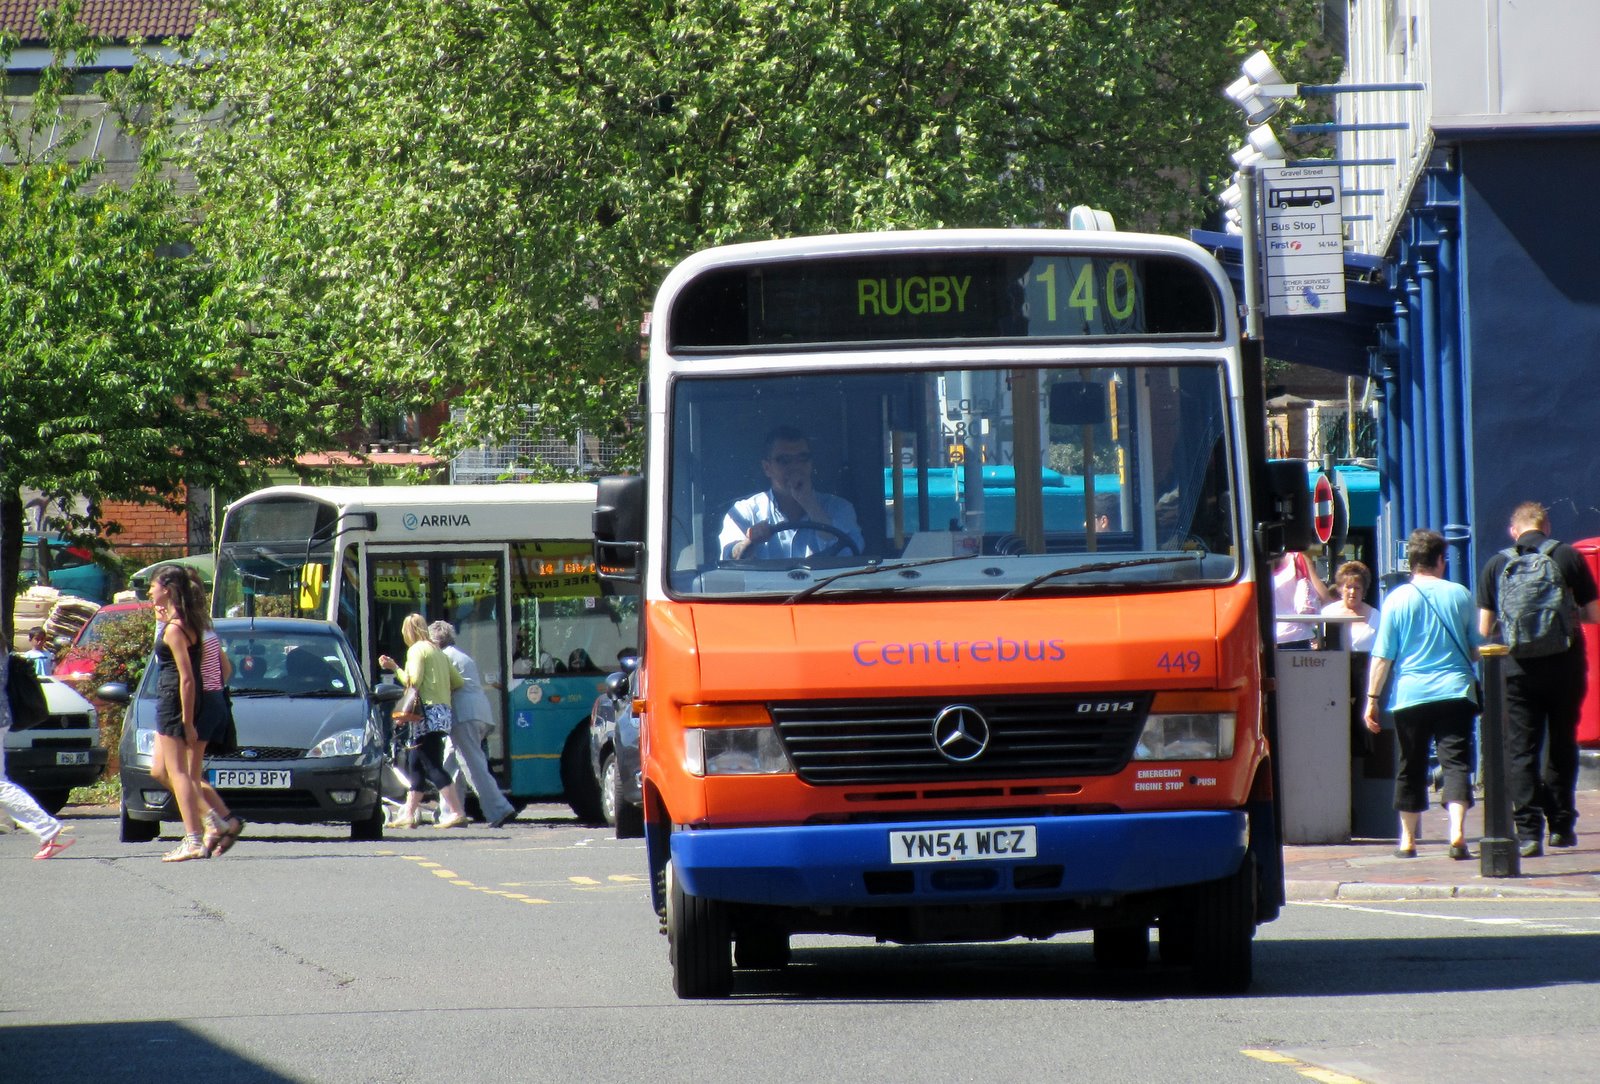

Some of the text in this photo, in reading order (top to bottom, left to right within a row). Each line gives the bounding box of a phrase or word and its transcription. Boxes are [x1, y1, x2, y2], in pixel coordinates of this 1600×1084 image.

[1271, 222, 1316, 231] Bus Stop
[1271, 241, 1289, 250] First
[857, 276, 972, 315] RUGBY
[1036, 262, 1136, 322] 140
[421, 515, 471, 527] ARRIVA
[540, 564, 554, 575] 14
[853, 636, 1066, 667] Centrebus
[1157, 650, 1201, 673] 449
[1292, 656, 1327, 668] Litter
[1096, 702, 1134, 712] 814
[260, 772, 288, 785] BPY
[1138, 769, 1182, 778] EMERGENCY
[1135, 782, 1184, 791] ENGINE STOP
[1197, 778, 1216, 786] PUSH
[902, 830, 1026, 858] YN54 WCZ
